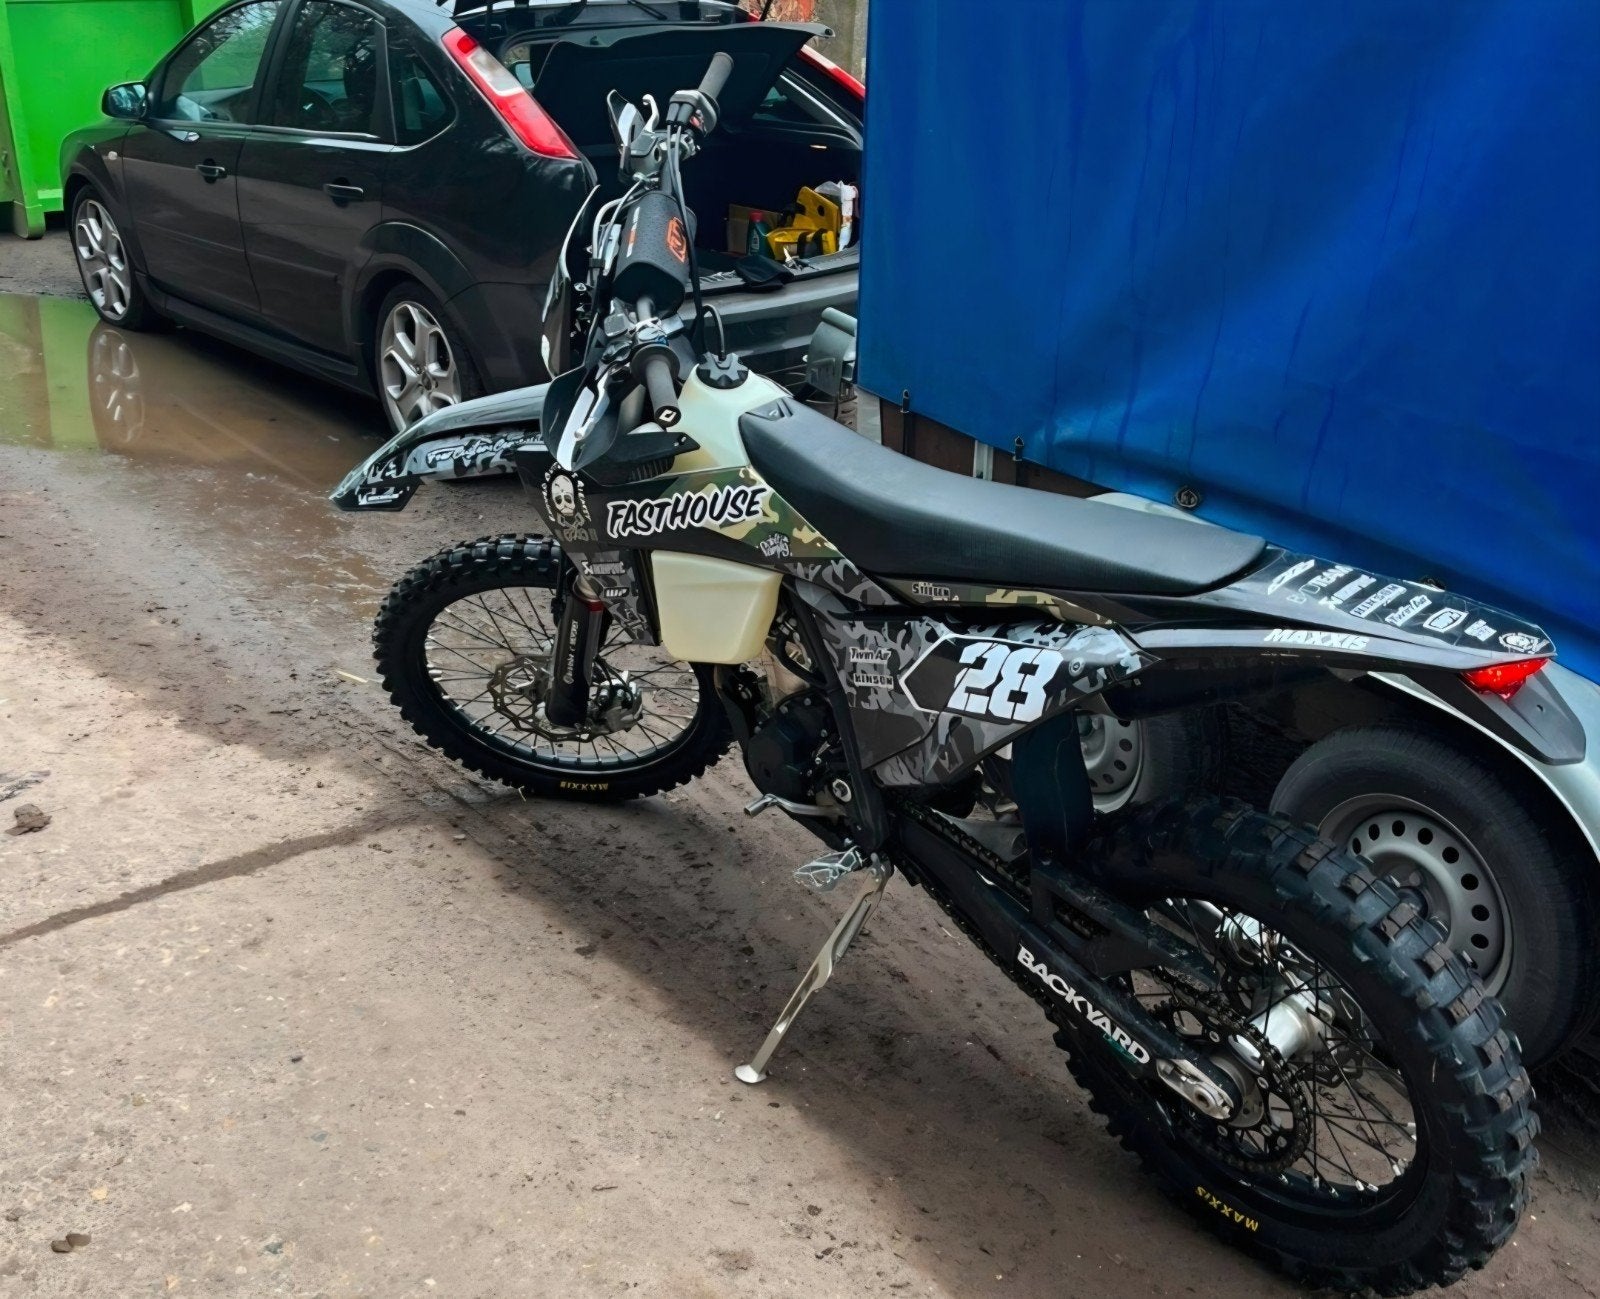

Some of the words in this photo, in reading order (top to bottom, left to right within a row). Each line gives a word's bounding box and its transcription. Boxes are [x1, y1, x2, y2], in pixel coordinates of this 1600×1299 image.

[607, 485, 767, 538] FASTHOUSE
[1264, 629, 1369, 652] MAXXIS
[947, 642, 1063, 722] 28
[1017, 946, 1150, 1064] BACKYARD
[1196, 1186, 1259, 1233] MAXXIS
